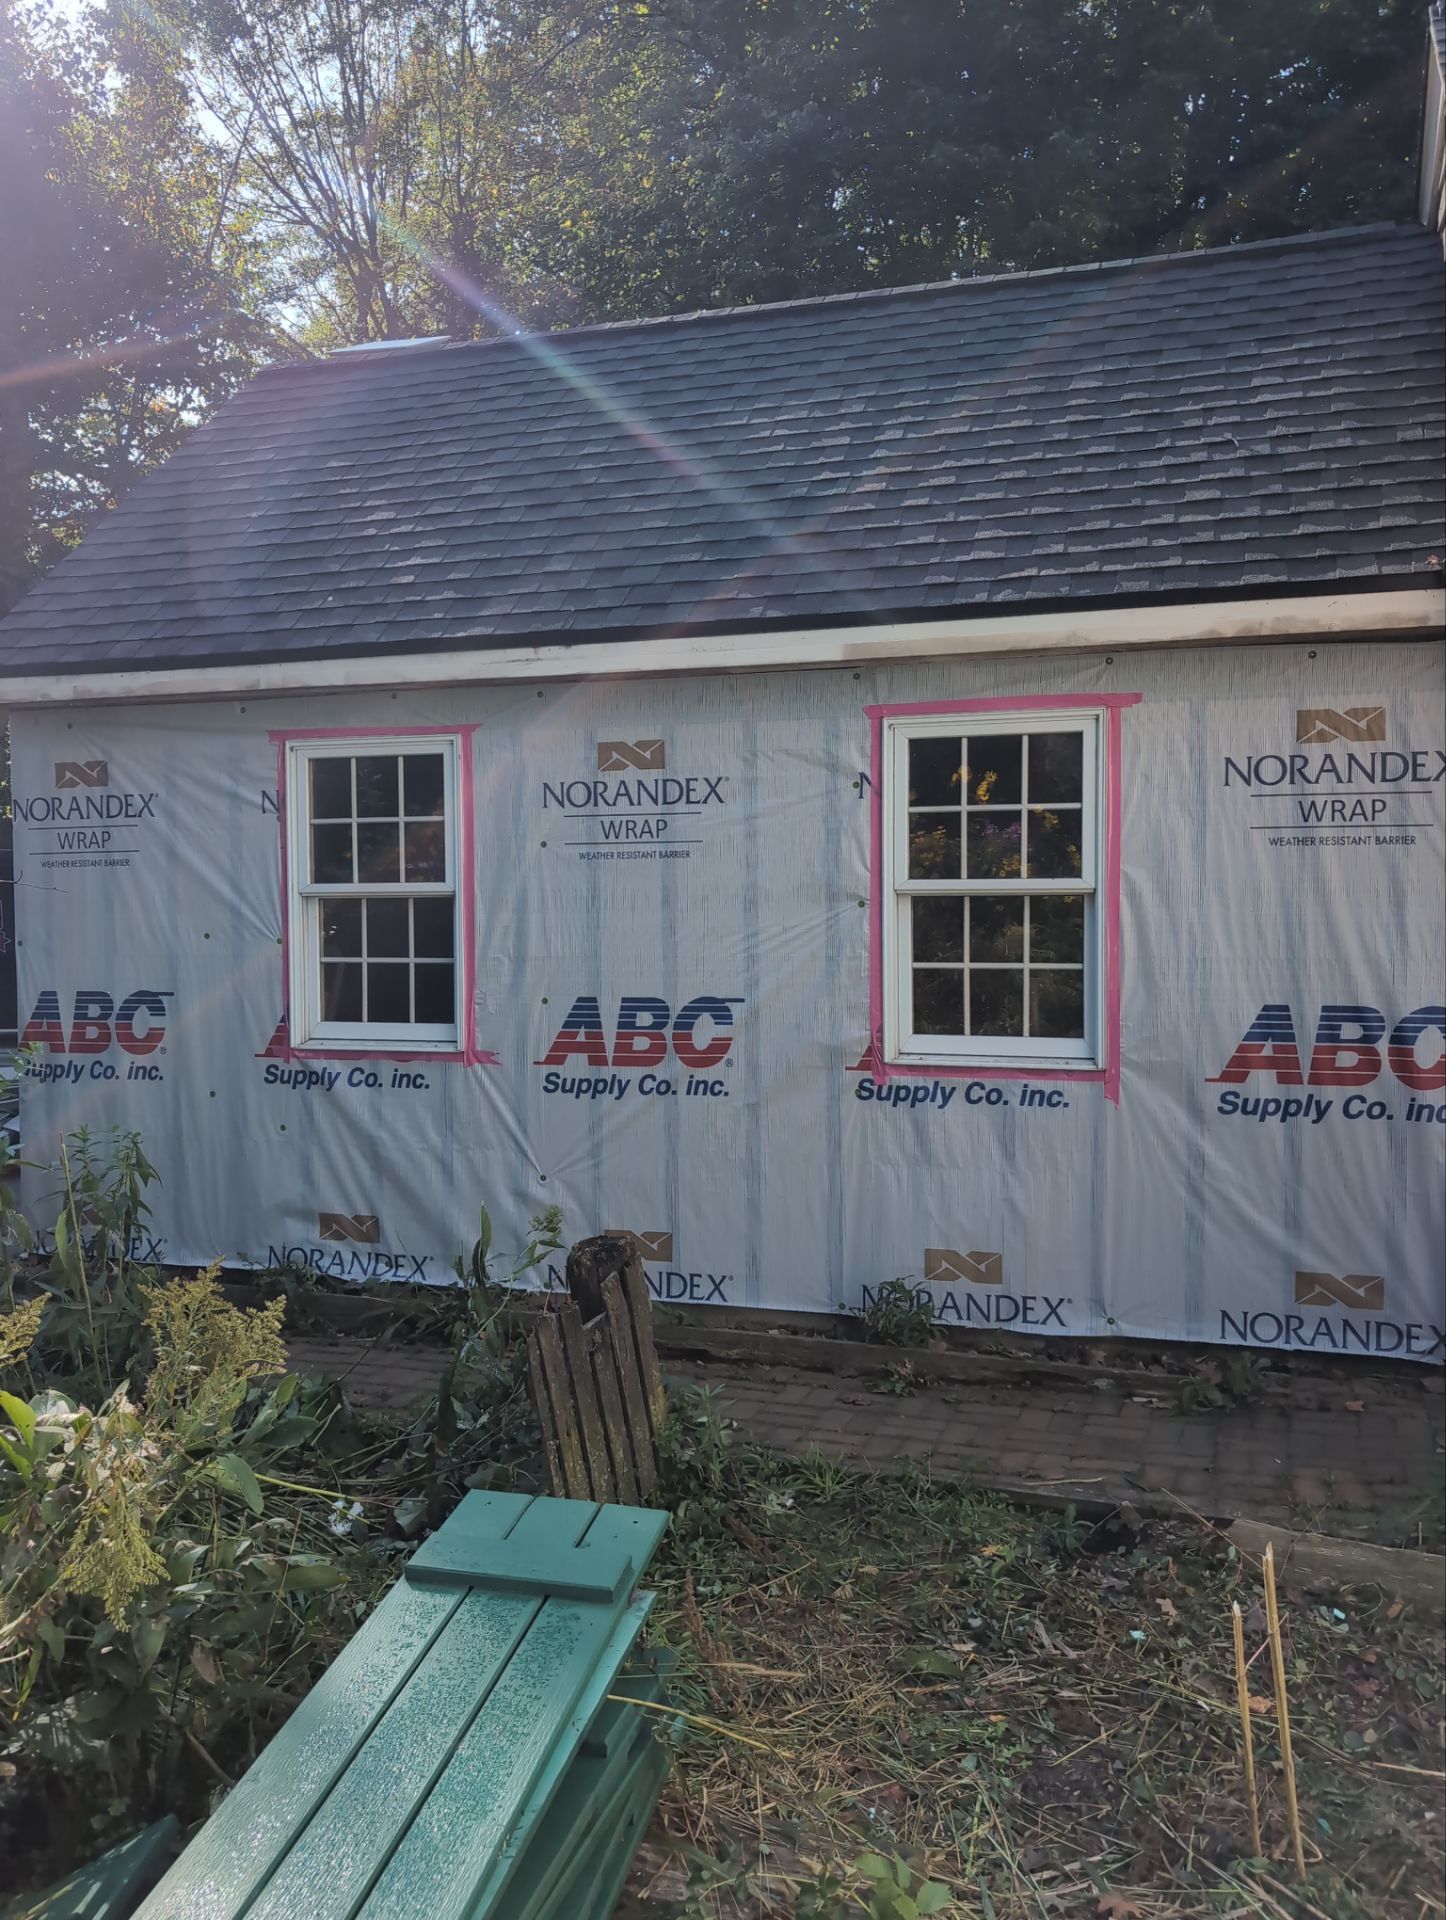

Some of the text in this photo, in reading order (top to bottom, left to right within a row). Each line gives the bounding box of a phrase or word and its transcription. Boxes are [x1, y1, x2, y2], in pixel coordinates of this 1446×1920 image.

[542, 776, 726, 808] NORANDEX
[14, 793, 156, 822] NORANDEX
[1298, 799, 1387, 822] WRAP
[57, 831, 111, 850] WRAP
[600, 819, 668, 840] WRAP
[1269, 835, 1417, 847] WEATHER RESISTANT BARRIER
[40, 860, 69, 868] WEATHER
[104, 858, 130, 867] BARRIER
[579, 850, 691, 860] WEATHER RESISTANT BARRIER
[18, 990, 174, 1056] ABC
[533, 996, 745, 1068] ABC
[1205, 1004, 1446, 1091] ABC
[90, 1060, 119, 1080] Co.
[127, 1062, 164, 1081] inc.
[264, 1064, 430, 1091] Supply Co. inc.
[542, 1072, 729, 1100] Supply Co. inc.
[857, 1078, 1069, 1109] Supply Co. inc.
[1217, 1091, 1333, 1124] Supply
[1342, 1094, 1394, 1121] Co.
[547, 1264, 728, 1302] NNDEX
